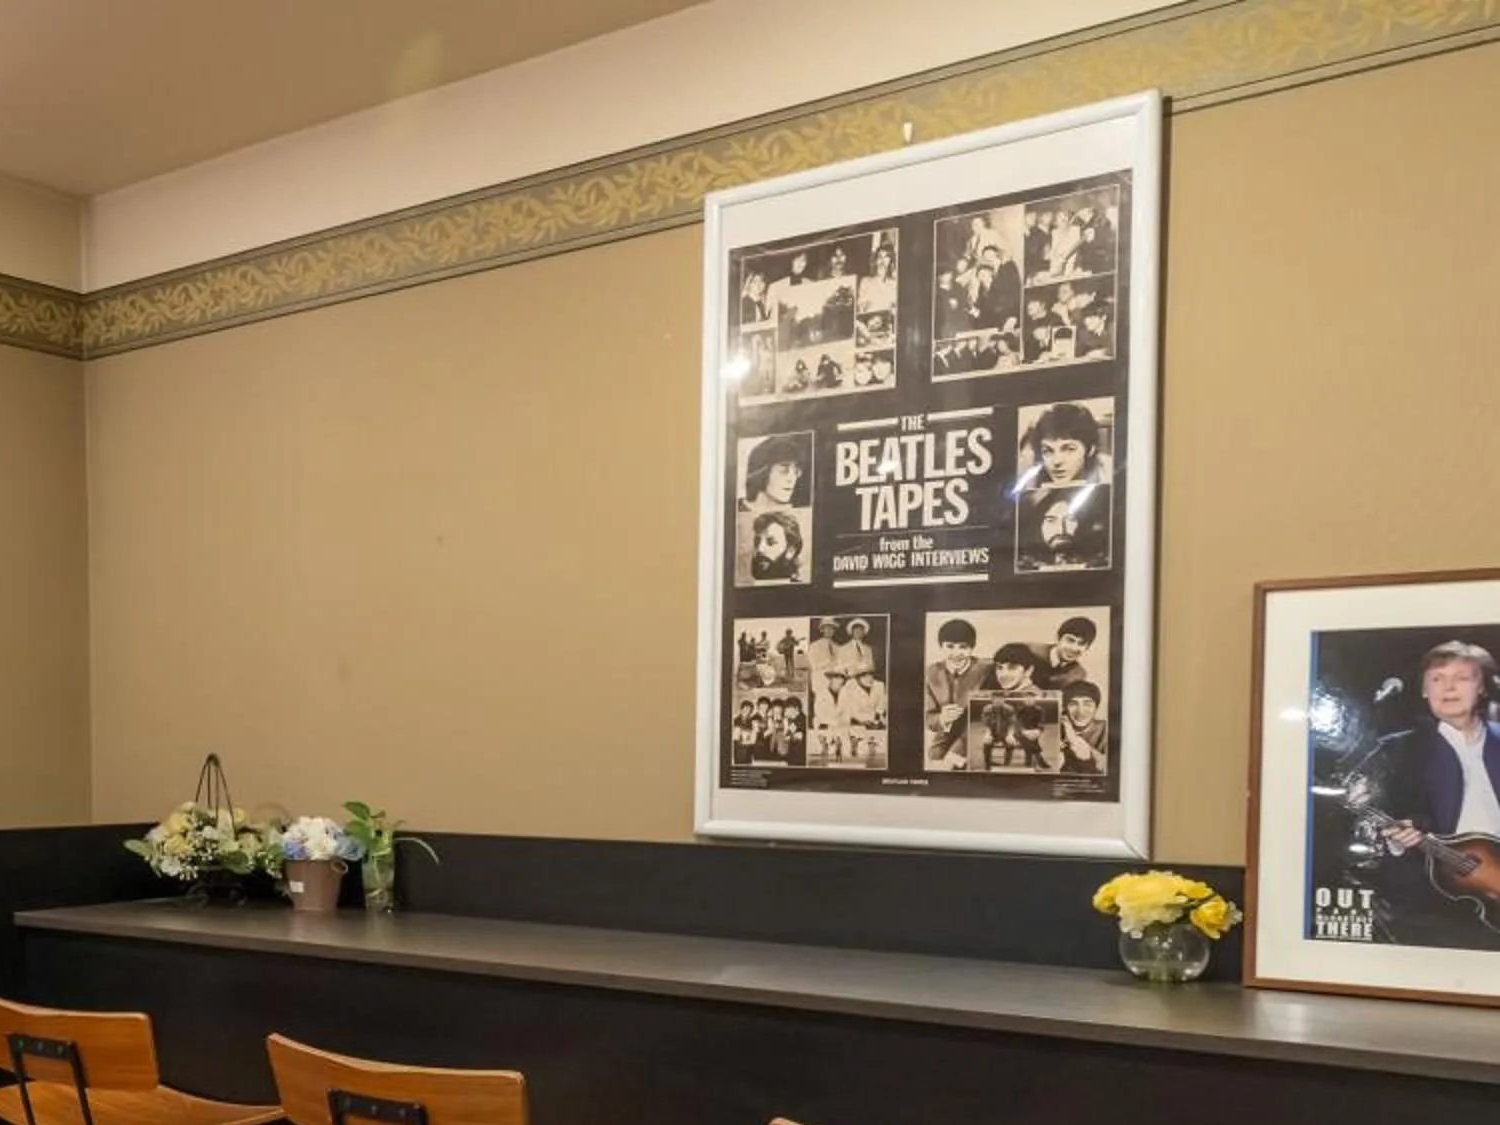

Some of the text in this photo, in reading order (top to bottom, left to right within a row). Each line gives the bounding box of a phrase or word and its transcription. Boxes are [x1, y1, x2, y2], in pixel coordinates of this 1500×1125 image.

[901, 414, 925, 432] THE
[835, 427, 993, 487] BEATLES
[855, 477, 969, 531] TAPES
[879, 535, 933, 551] from the
[833, 554, 868, 573] DAVID
[911, 547, 989, 567] INTERVIEWS
[1315, 887, 1374, 908] OUT
